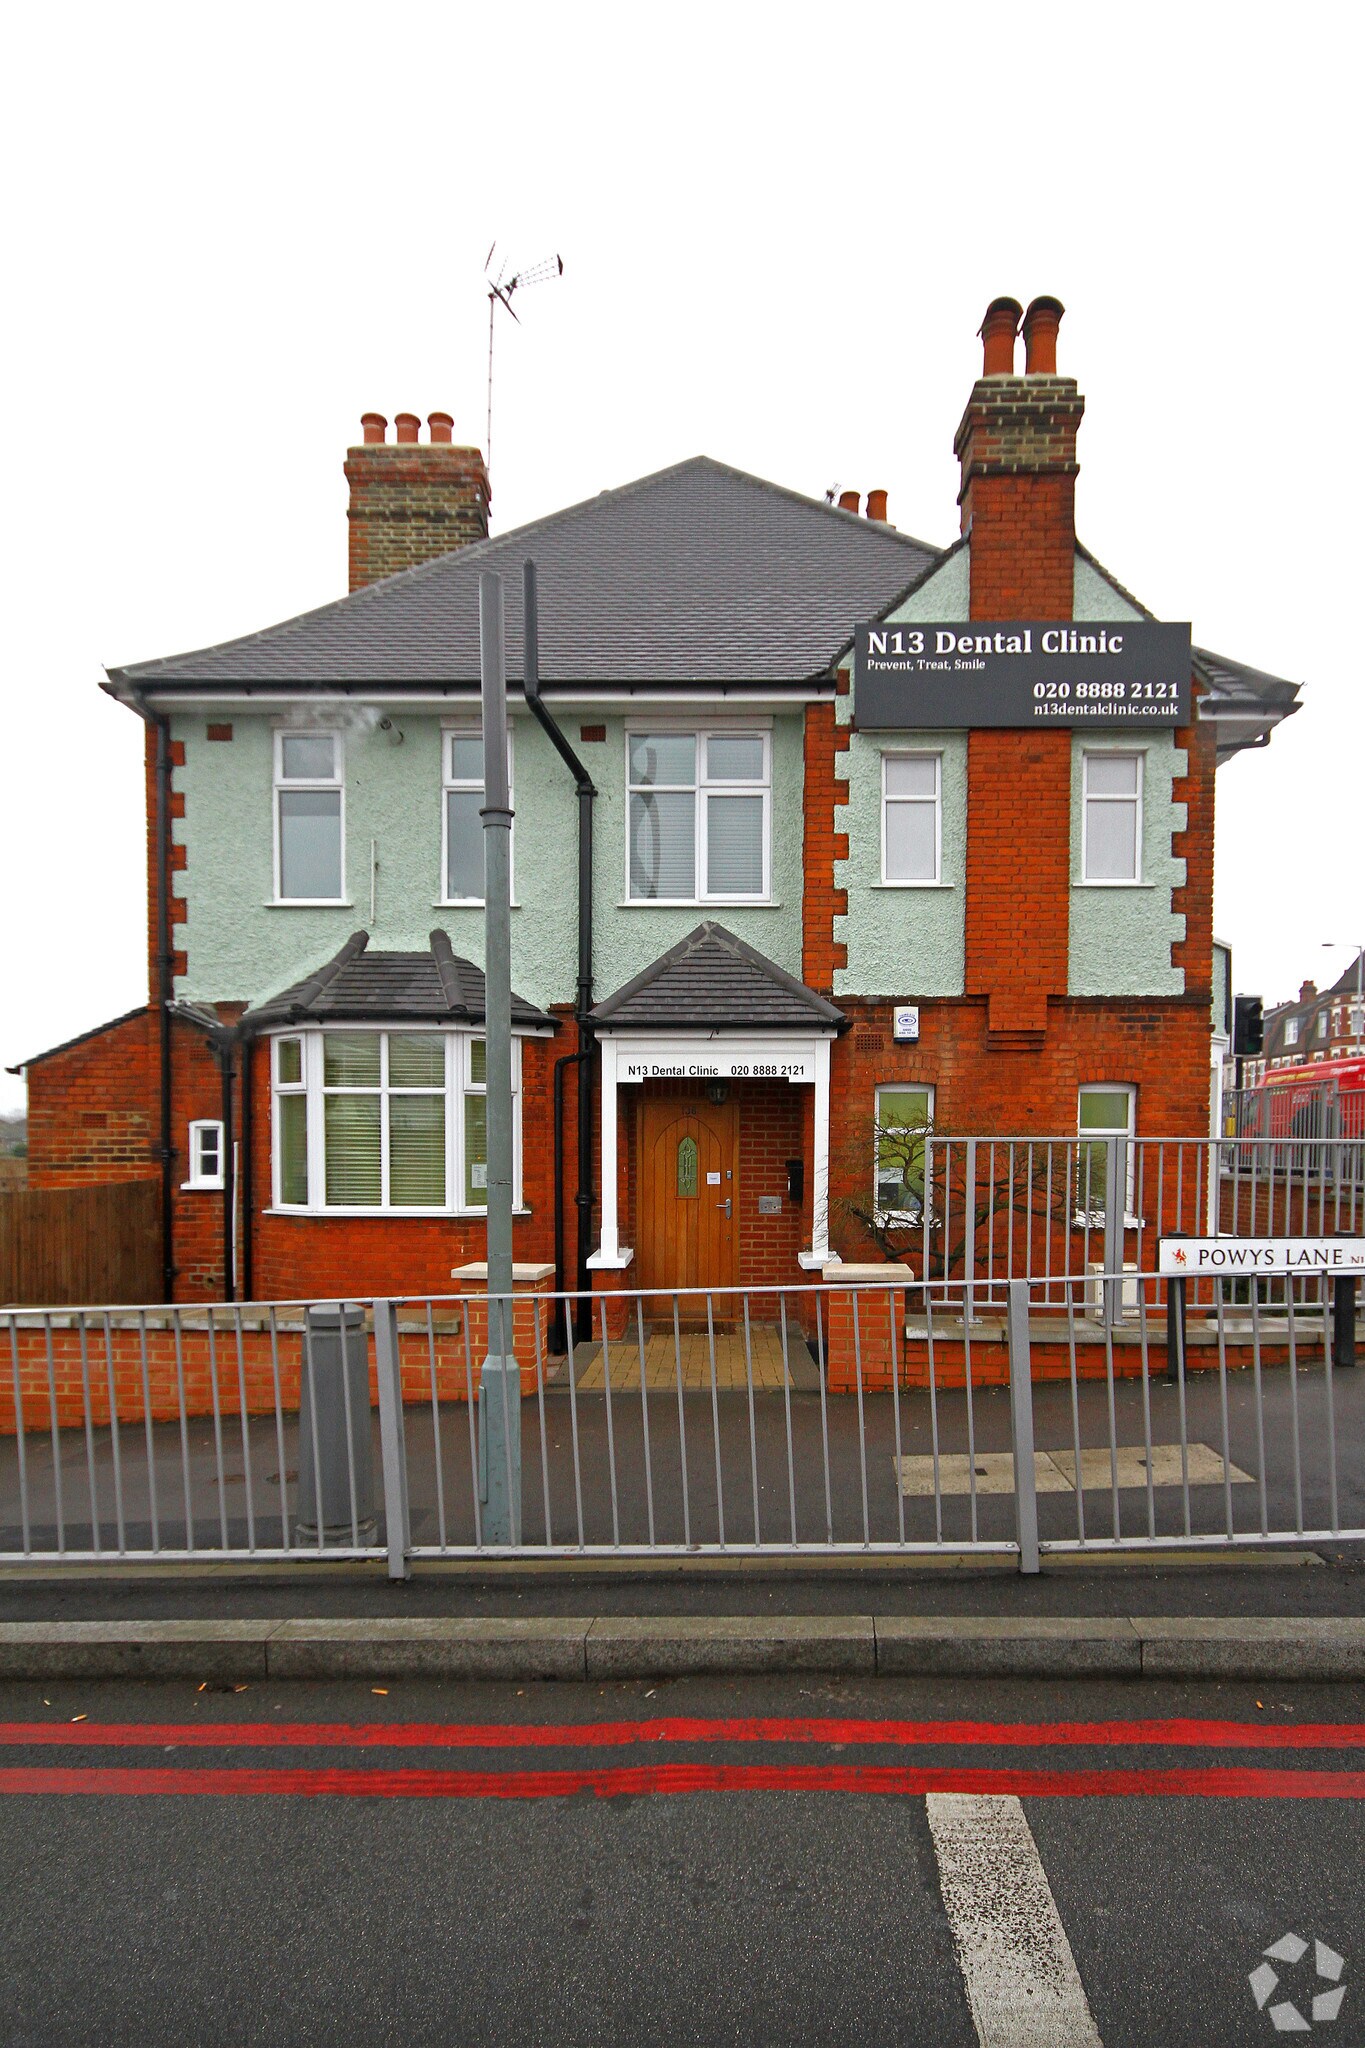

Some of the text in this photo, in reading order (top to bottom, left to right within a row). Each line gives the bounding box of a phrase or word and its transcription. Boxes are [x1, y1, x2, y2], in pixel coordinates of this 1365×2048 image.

[867, 629, 1123, 655] N13 Dental Clinic
[867, 658, 986, 671] Prevent, Treat, Smile
[1033, 682, 1180, 699] 020 8888 2121
[1034, 702, 1179, 716] n13dentalclinic.co.uk
[628, 1065, 804, 1076] N13 Dental Clinic 020 8888 2121
[1198, 1248, 1275, 1266] POWYS
[1286, 1248, 1343, 1266] LANE
